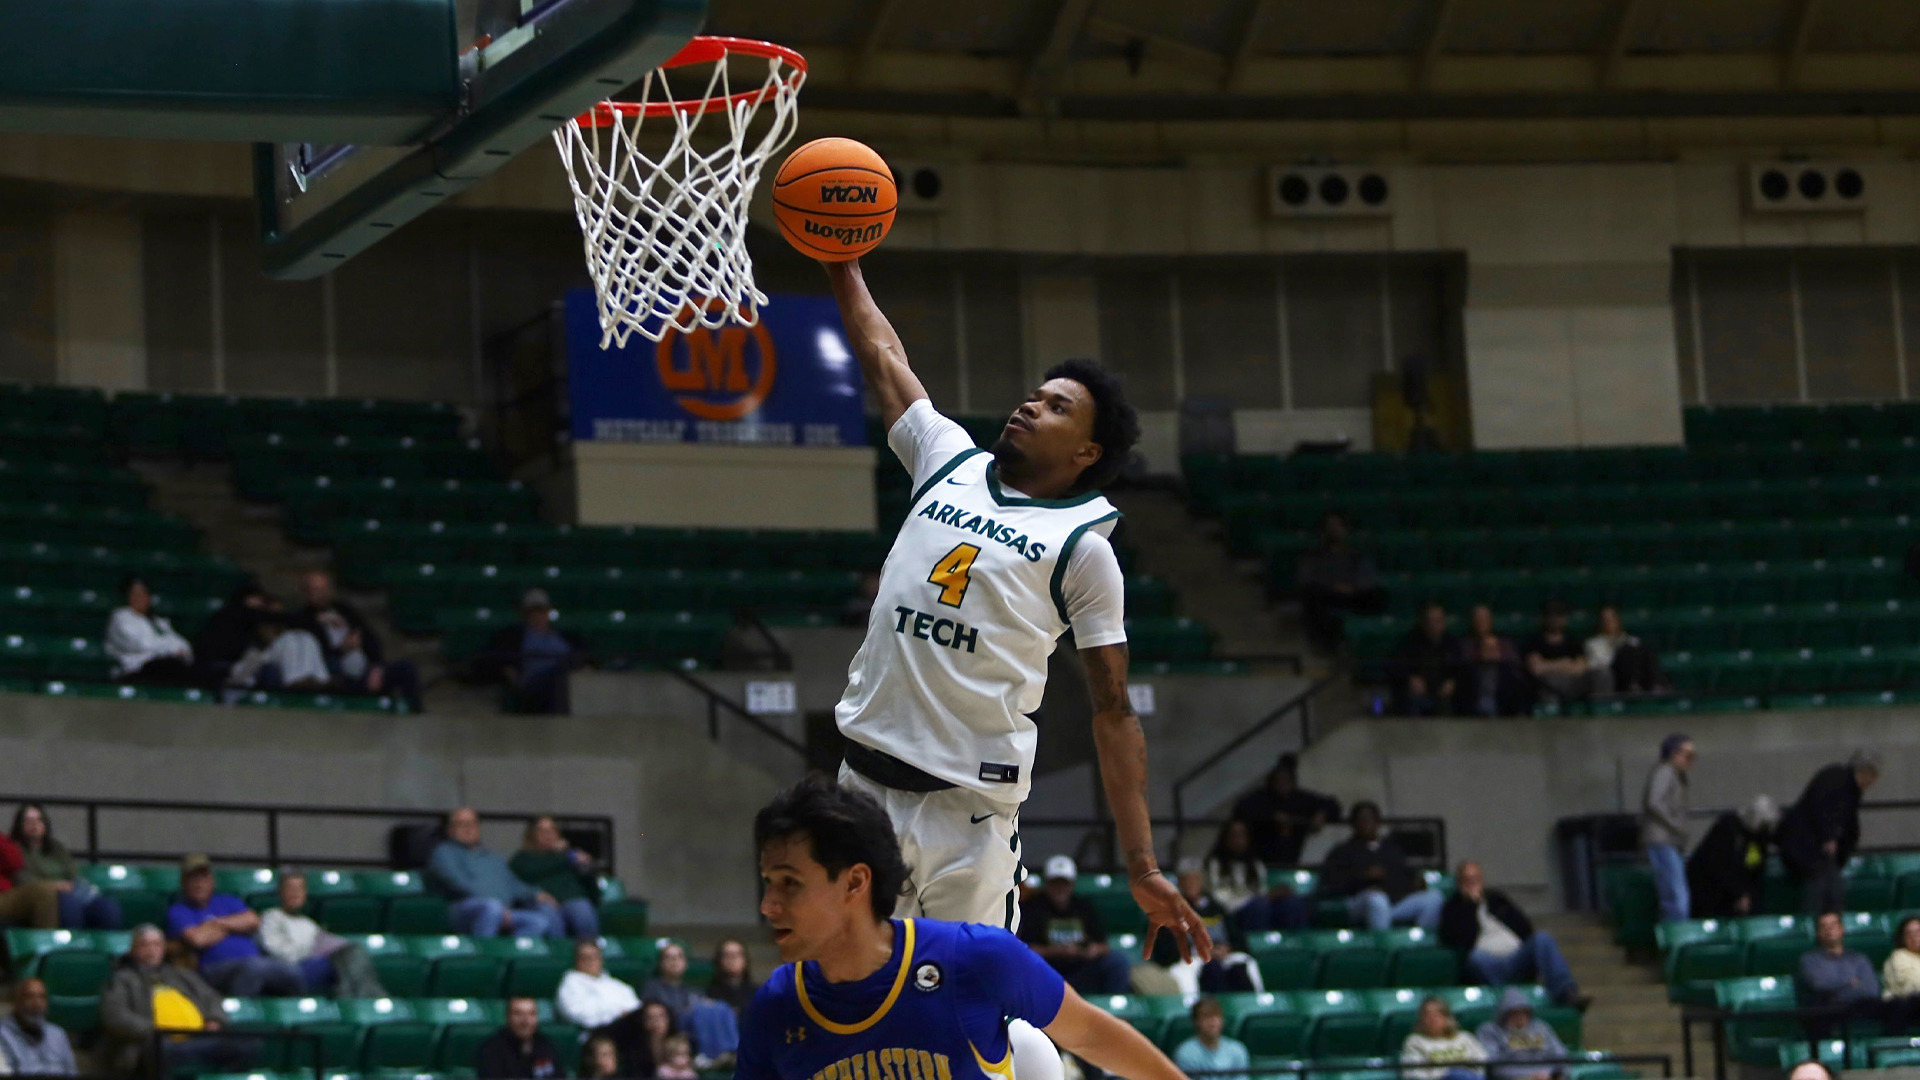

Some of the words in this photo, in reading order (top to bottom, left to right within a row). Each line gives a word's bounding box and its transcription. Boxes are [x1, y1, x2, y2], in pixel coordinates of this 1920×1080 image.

[821, 185, 878, 203] NCAA
[804, 219, 883, 245] Wilson
[917, 500, 1047, 562] ARKANSAS
[926, 541, 982, 609] 4
[895, 606, 979, 653] TECH
